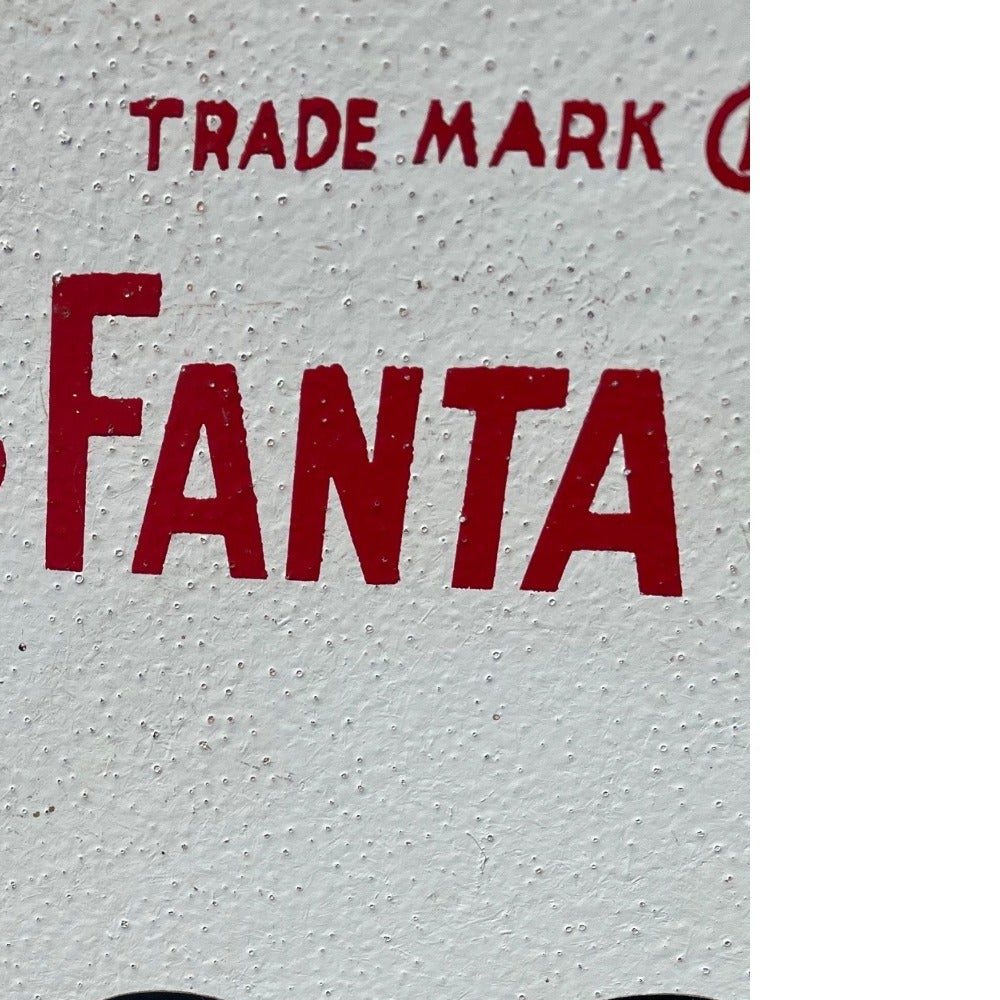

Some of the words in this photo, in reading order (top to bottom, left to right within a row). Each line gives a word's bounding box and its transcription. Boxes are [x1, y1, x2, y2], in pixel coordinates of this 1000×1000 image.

[129, 96, 379, 171] TRADE
[414, 99, 666, 169] MARK
[45, 272, 683, 597] FANTA
